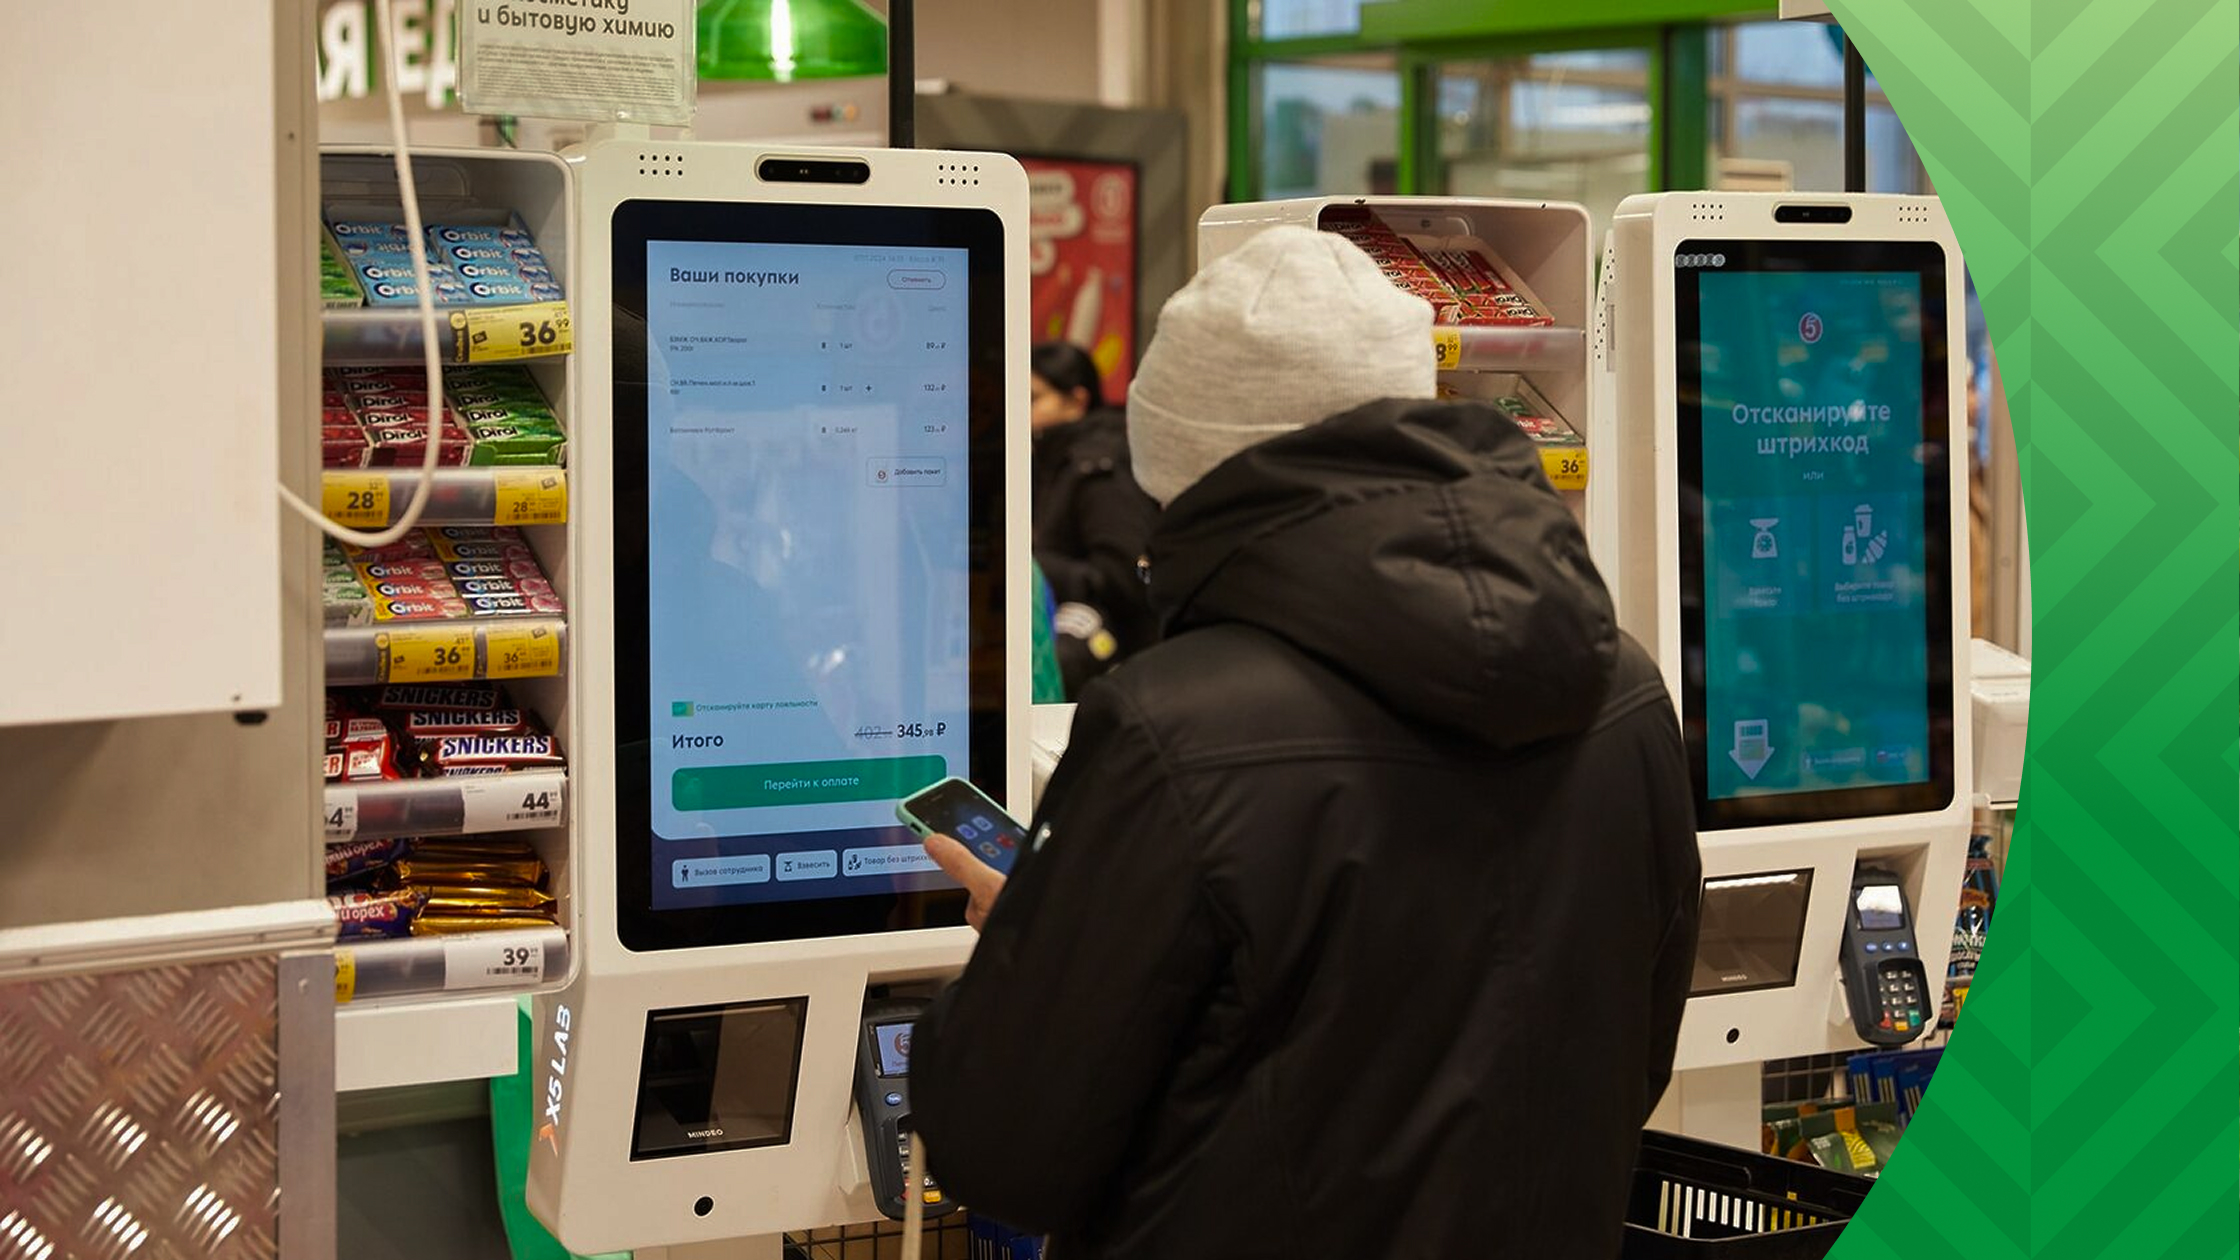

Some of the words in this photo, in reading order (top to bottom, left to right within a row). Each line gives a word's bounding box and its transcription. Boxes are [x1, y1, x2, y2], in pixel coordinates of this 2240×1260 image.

[478, 7, 490, 24] и
[497, 5, 597, 36] бытовую
[602, 18, 675, 39] химию
[335, 224, 382, 236] Orbit
[443, 229, 492, 242] Orbit
[455, 246, 504, 259] Orbit
[462, 264, 511, 278] Orbit
[670, 266, 720, 284] Ваши
[724, 268, 800, 287] покупки
[473, 283, 523, 297] Orbit
[520, 320, 556, 347] 36
[362, 396, 404, 406] Dirol
[461, 394, 499, 406] Dirol
[367, 413, 409, 423] Dirol
[469, 409, 508, 421] Dirol
[1732, 399, 1892, 427] Отсканируйте
[382, 429, 422, 441] Dirol
[479, 426, 518, 439] Dirol
[1757, 433, 1870, 458] штрихкод
[1561, 459, 1579, 473] 36
[1803, 470, 1824, 481] или
[347, 491, 374, 510] 28
[513, 501, 528, 513] 28
[370, 564, 413, 578] Orbit
[455, 562, 501, 576] Orbit
[380, 582, 424, 596] Orbit
[466, 579, 514, 593] Orbit
[390, 600, 435, 615] Orbit
[476, 597, 525, 610] Orbit
[434, 646, 462, 666] 36
[504, 652, 519, 664] 36
[385, 686, 496, 708] SNICKERS
[751, 701, 773, 711] карту
[413, 710, 520, 727] SNICKERS
[442, 736, 549, 758] SNICKERS
[672, 734, 724, 749] Итого
[764, 778, 811, 791] Перейти
[821, 775, 860, 788] оплате
[522, 792, 550, 811] 44
[503, 948, 530, 966] 39
[545, 1075, 566, 1126] X5
[687, 1128, 724, 1139] MINDEO
